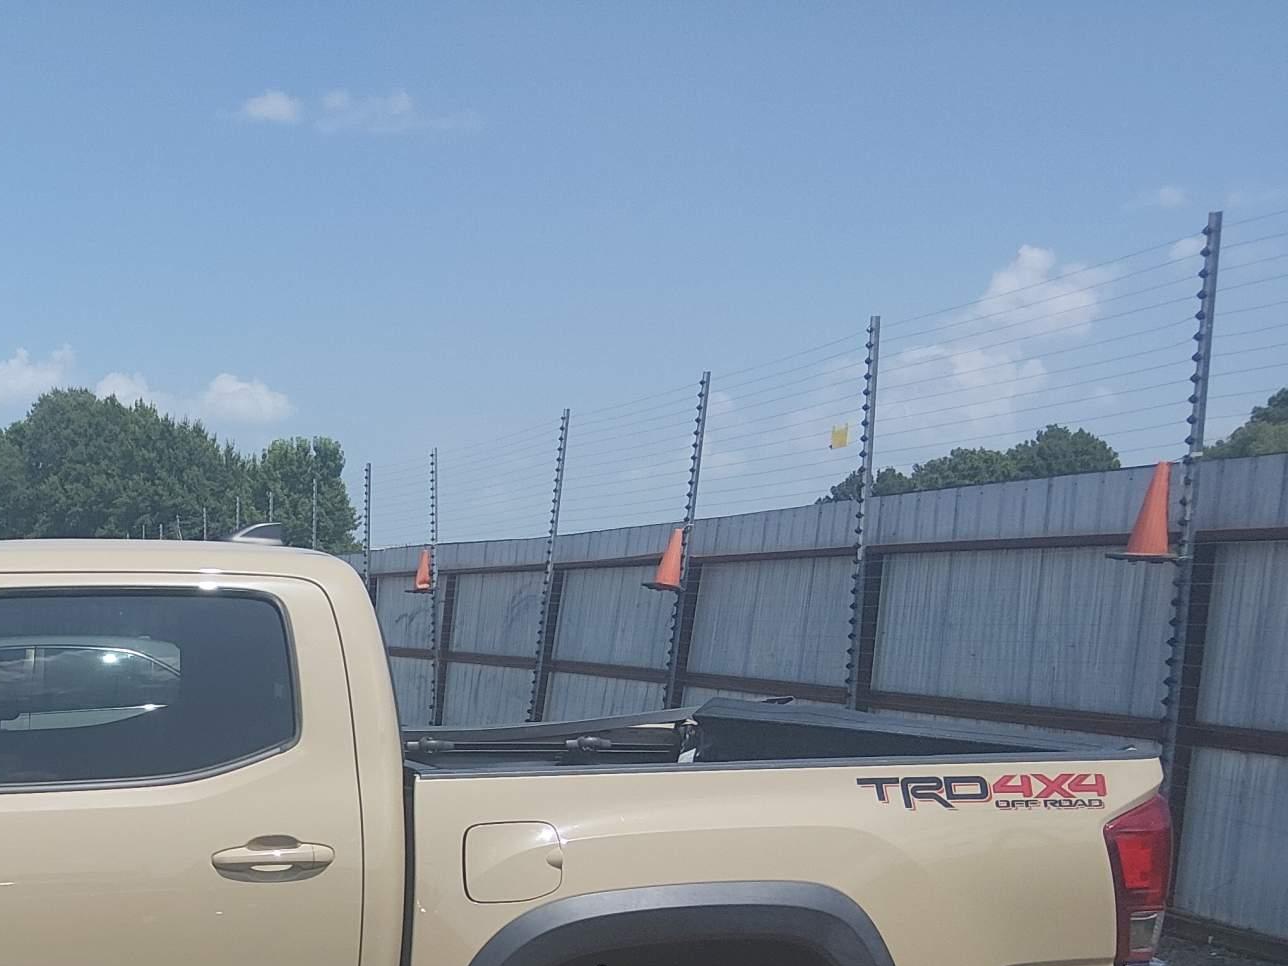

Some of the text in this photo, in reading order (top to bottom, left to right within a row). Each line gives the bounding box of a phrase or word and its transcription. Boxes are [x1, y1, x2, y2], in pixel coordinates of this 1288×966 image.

[856, 775, 993, 811] TRD
[995, 798, 1106, 811] OFF ROAD
